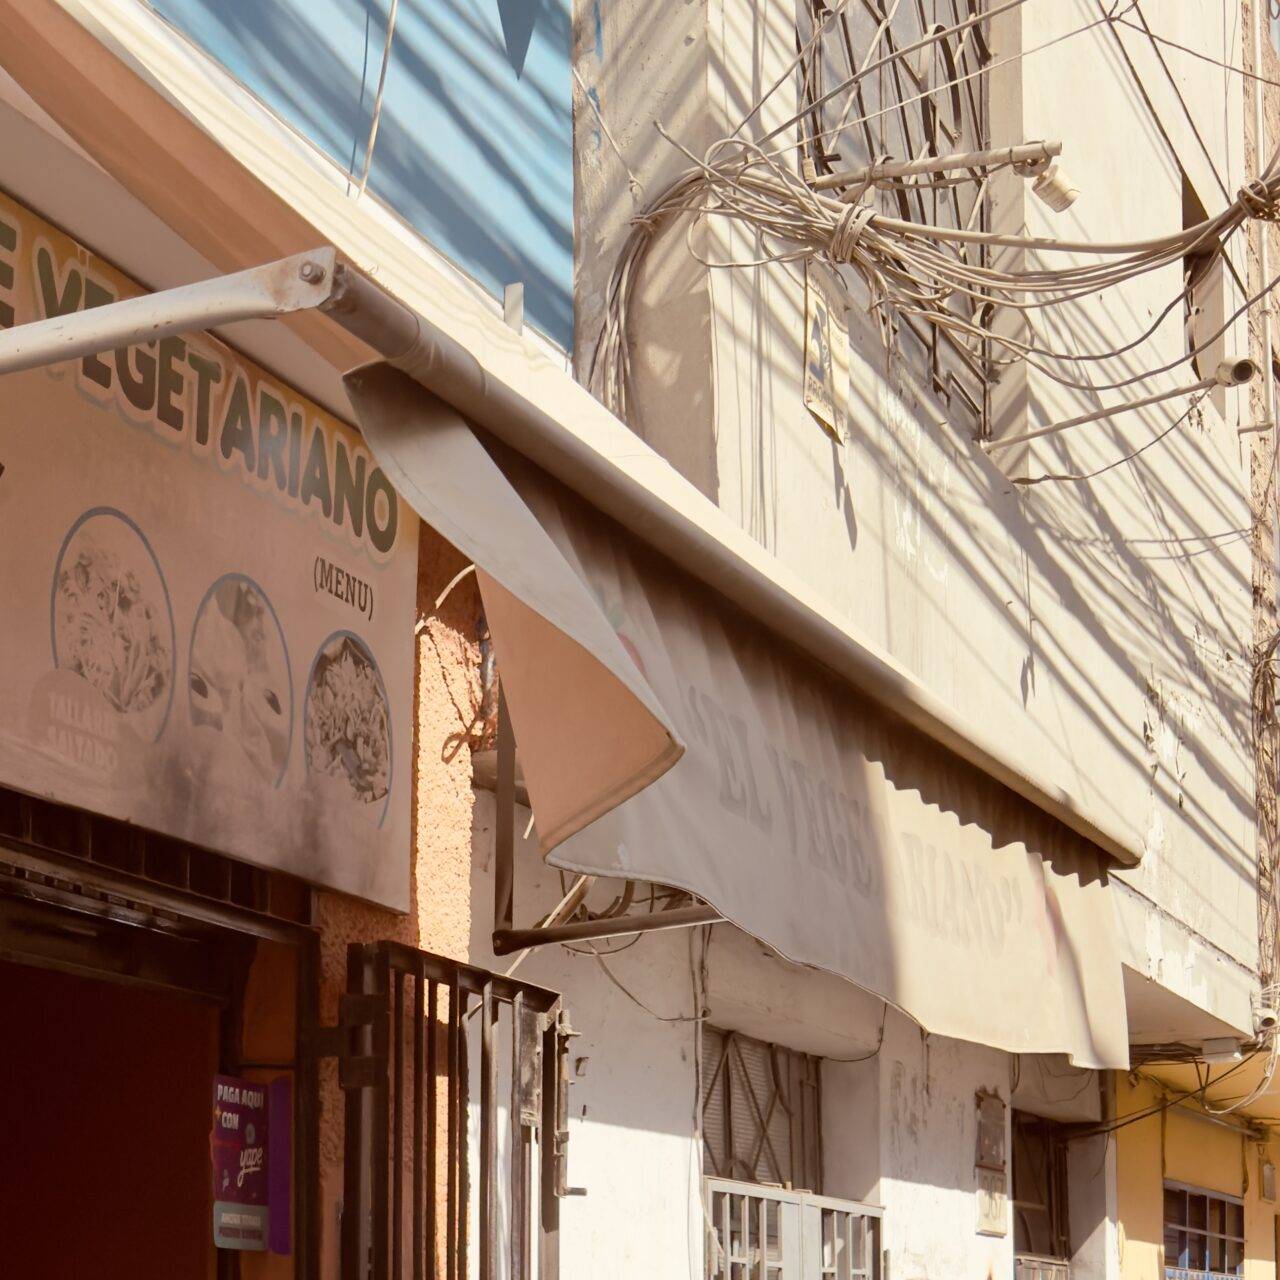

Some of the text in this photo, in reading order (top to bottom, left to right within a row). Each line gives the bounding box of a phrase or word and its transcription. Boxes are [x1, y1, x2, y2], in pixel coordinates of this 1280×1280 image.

[313, 556, 374, 621] (MENU)
[217, 1084, 240, 1104] PAGA
[222, 1111, 239, 1130] CON
